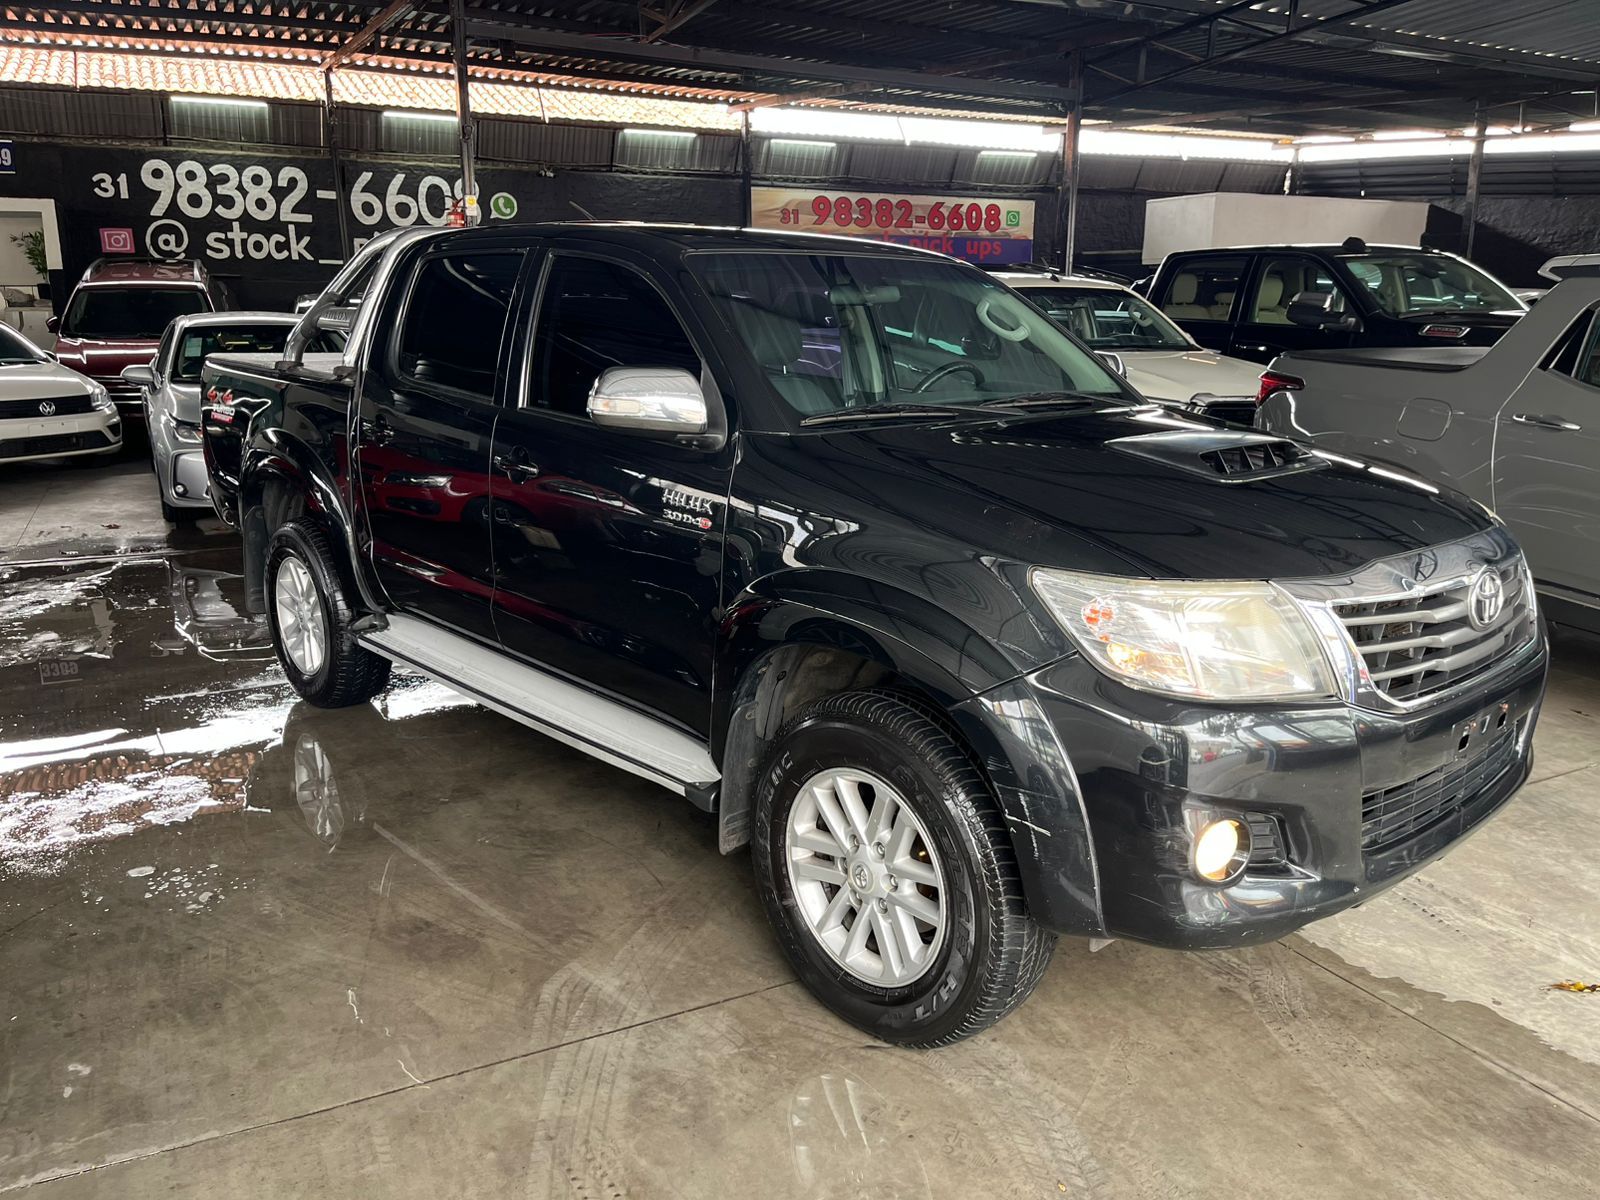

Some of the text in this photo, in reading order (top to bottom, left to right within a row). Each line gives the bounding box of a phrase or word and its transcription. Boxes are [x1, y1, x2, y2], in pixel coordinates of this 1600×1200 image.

[0, 148, 12, 166] 9
[92, 172, 129, 199] 31
[780, 195, 1001, 232] 31 98382-6608
